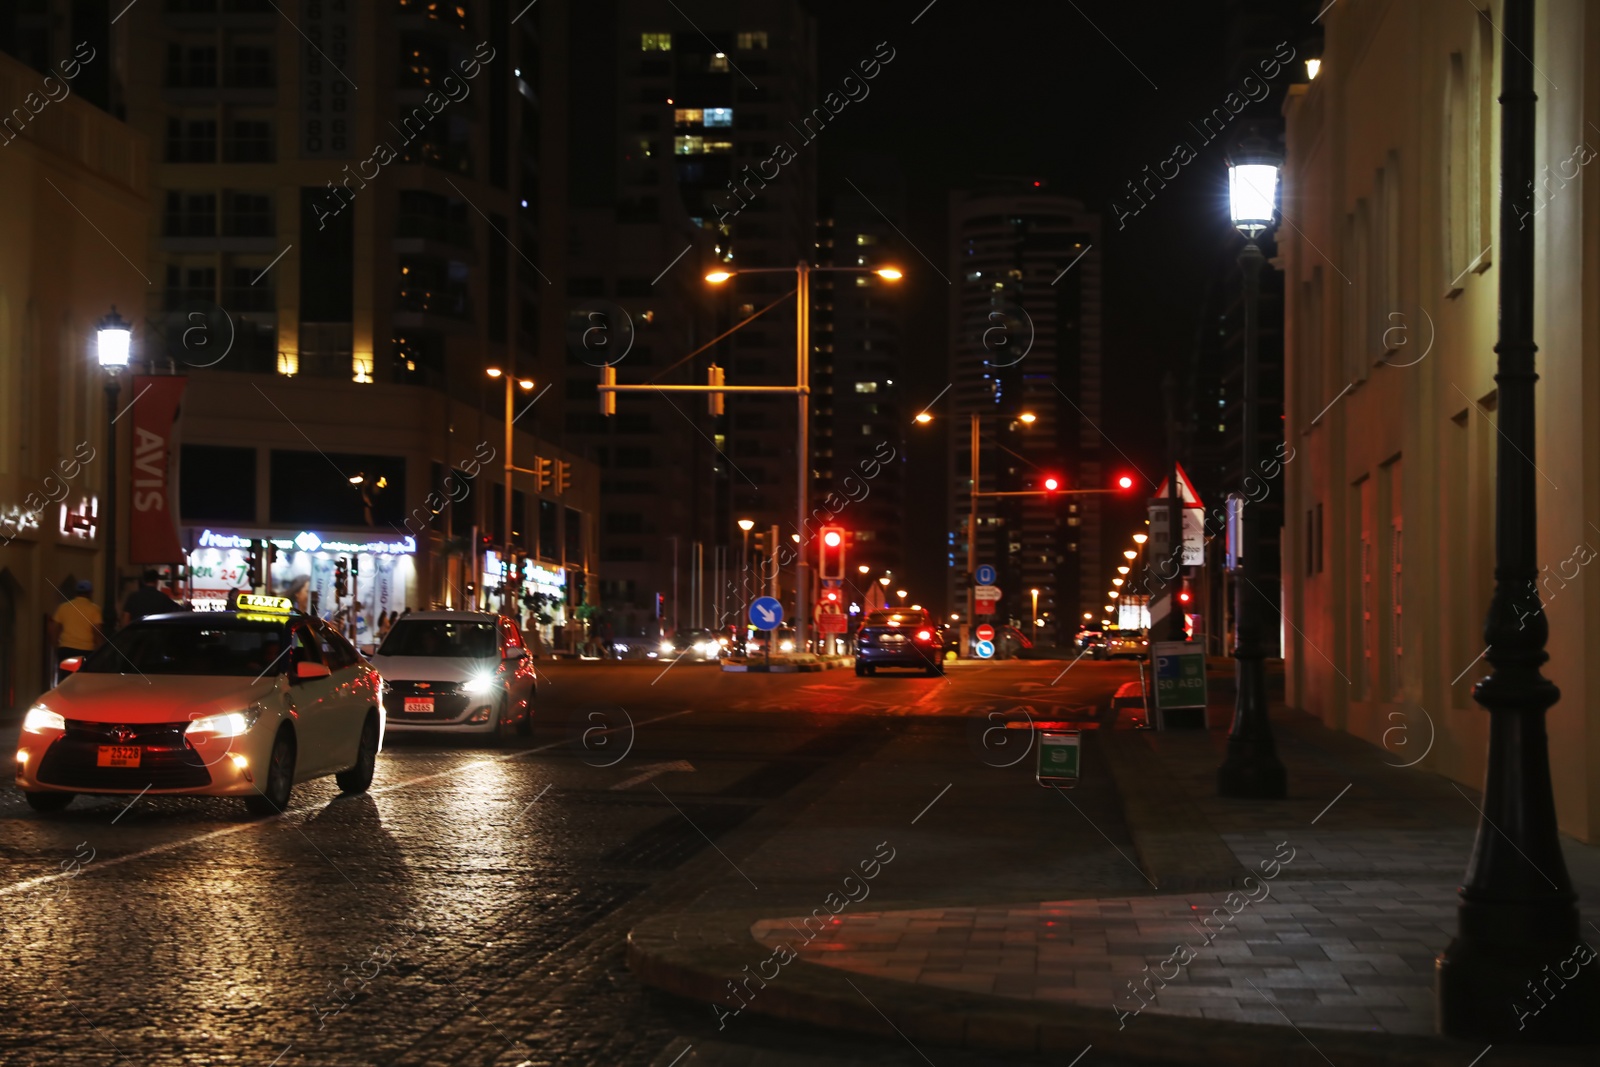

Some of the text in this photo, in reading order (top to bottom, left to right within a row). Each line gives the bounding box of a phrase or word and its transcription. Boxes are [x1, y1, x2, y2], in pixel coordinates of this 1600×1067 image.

[133, 426, 165, 513] AVIS
[246, 595, 280, 608] TAXI
[1157, 657, 1169, 673] P
[1178, 677, 1203, 689] AED
[111, 747, 139, 759] 25228
